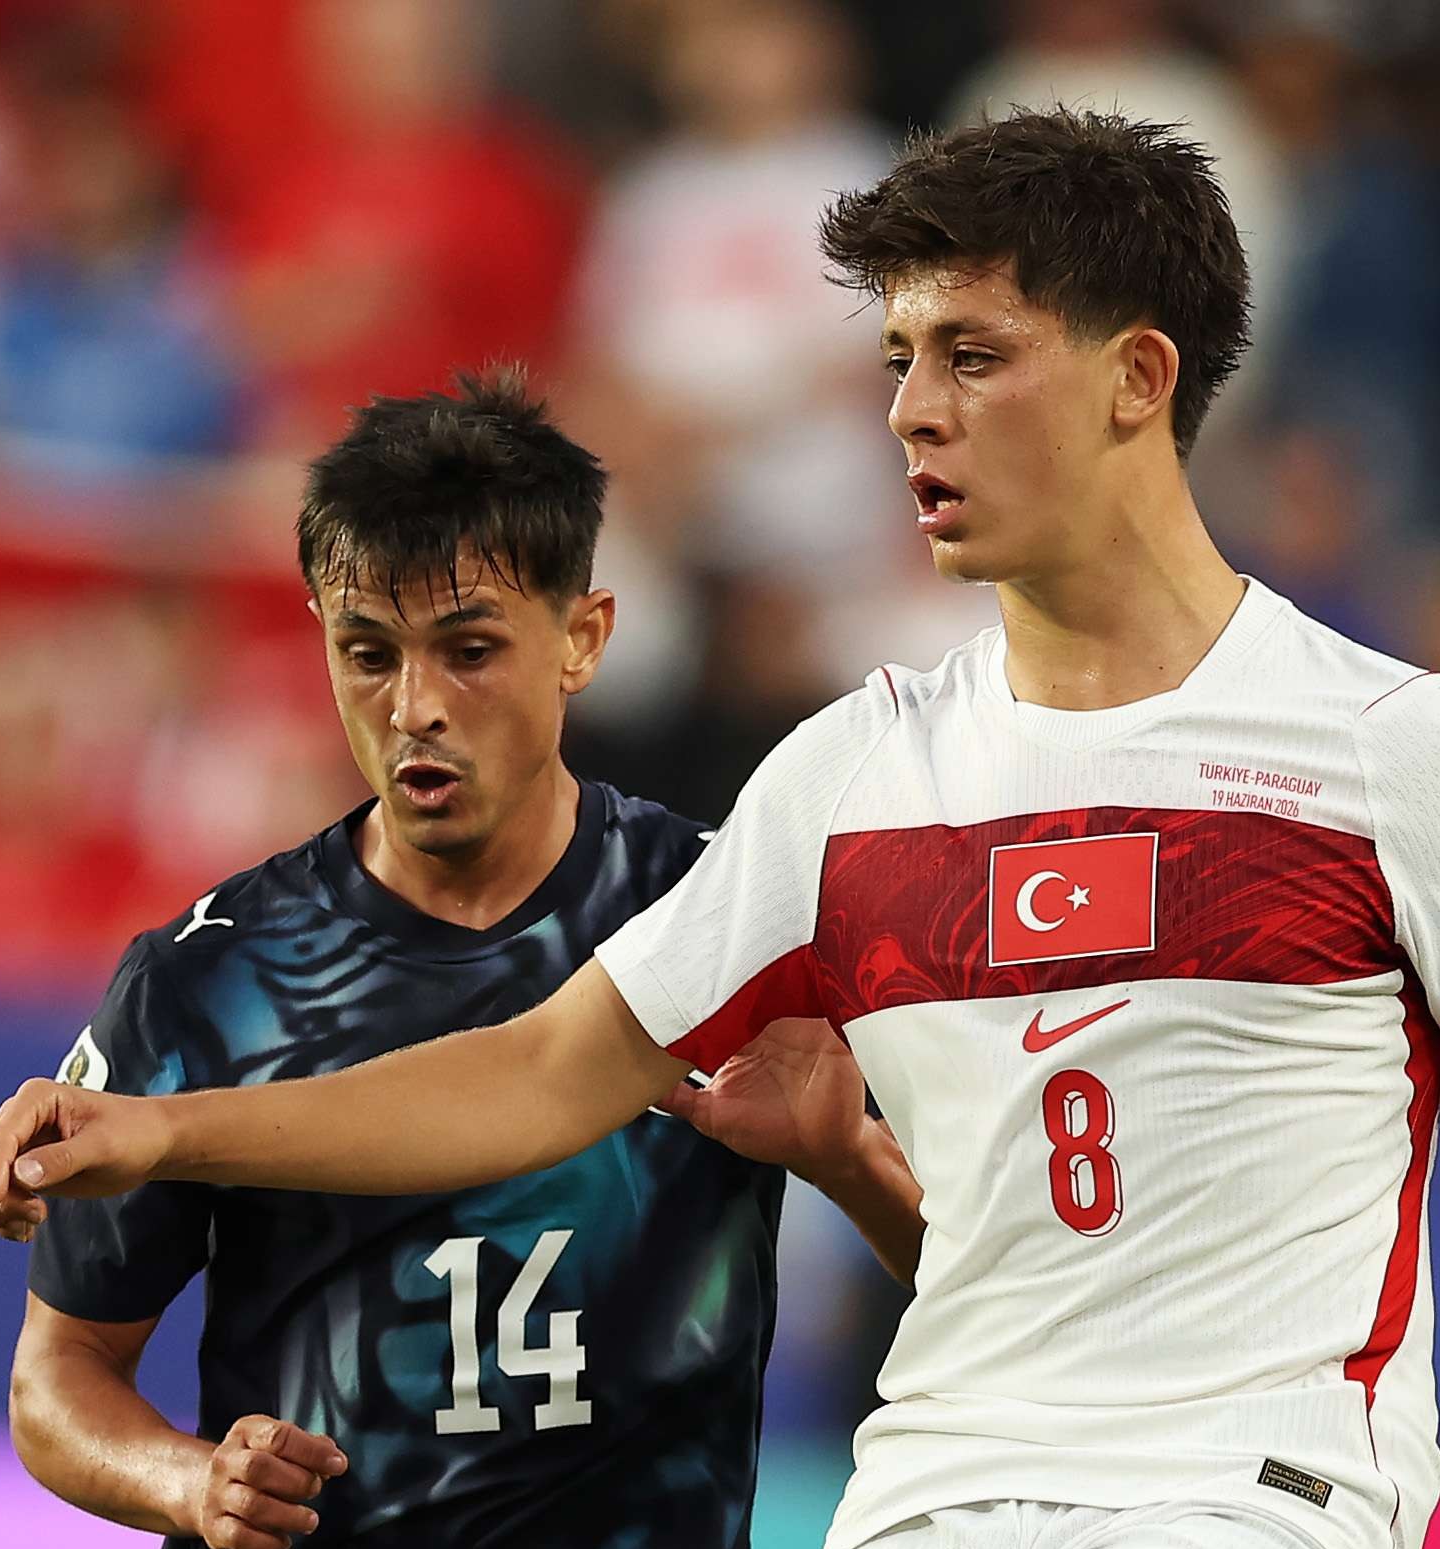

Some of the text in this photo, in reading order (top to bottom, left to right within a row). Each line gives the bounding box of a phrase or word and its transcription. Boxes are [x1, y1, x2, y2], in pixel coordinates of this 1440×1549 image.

[1199, 761, 1322, 797] TÜRKİYE-PARAGUAY
[1212, 789, 1300, 818] 19 HAZİRAN 2026
[1042, 1068, 1123, 1237] 8
[423, 1229, 592, 1434] 14
